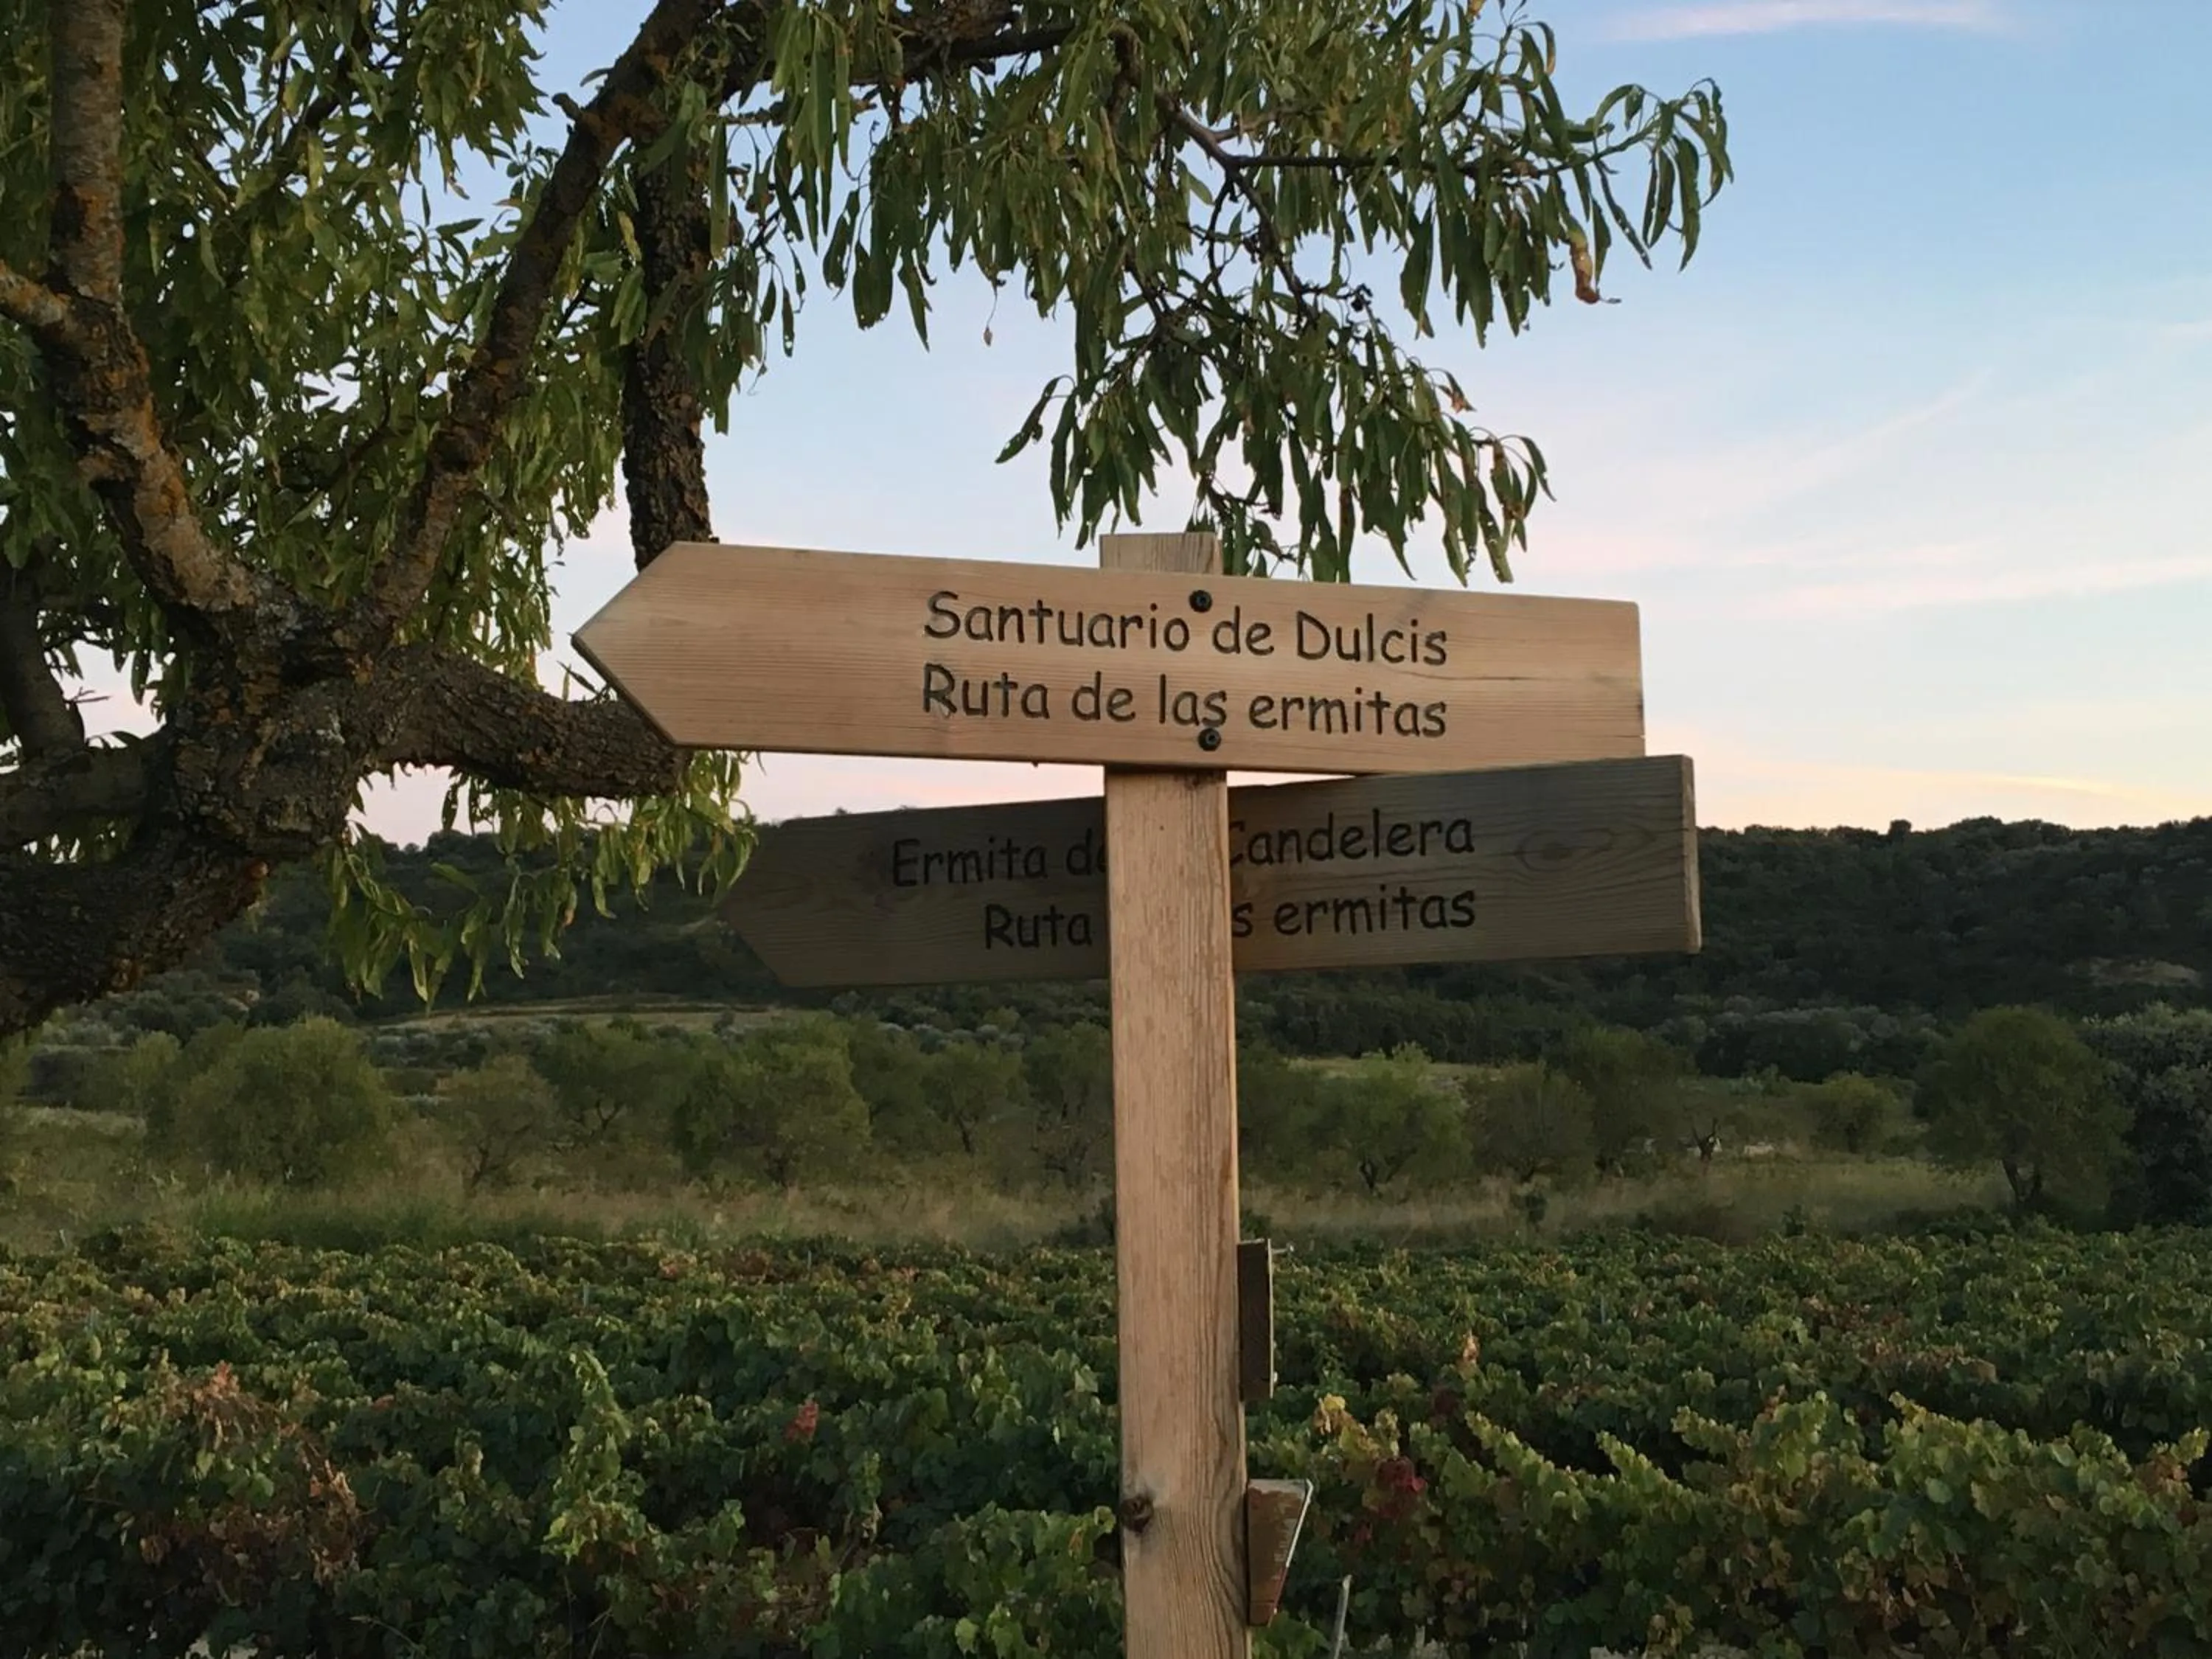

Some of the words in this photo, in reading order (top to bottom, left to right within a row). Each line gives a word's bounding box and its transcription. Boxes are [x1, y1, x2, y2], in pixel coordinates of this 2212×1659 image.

[922, 591, 1191, 652] Santuario
[1211, 605, 1275, 656] de
[1295, 610, 1447, 665] Dulcis
[922, 664, 1050, 719] Ruta
[1071, 671, 1136, 722] de
[1158, 674, 1227, 728] las
[1248, 686, 1446, 738] ermitas
[893, 835, 1048, 887] Ermita
[984, 902, 1092, 950] Ruta
[1273, 883, 1475, 936] ermitas
